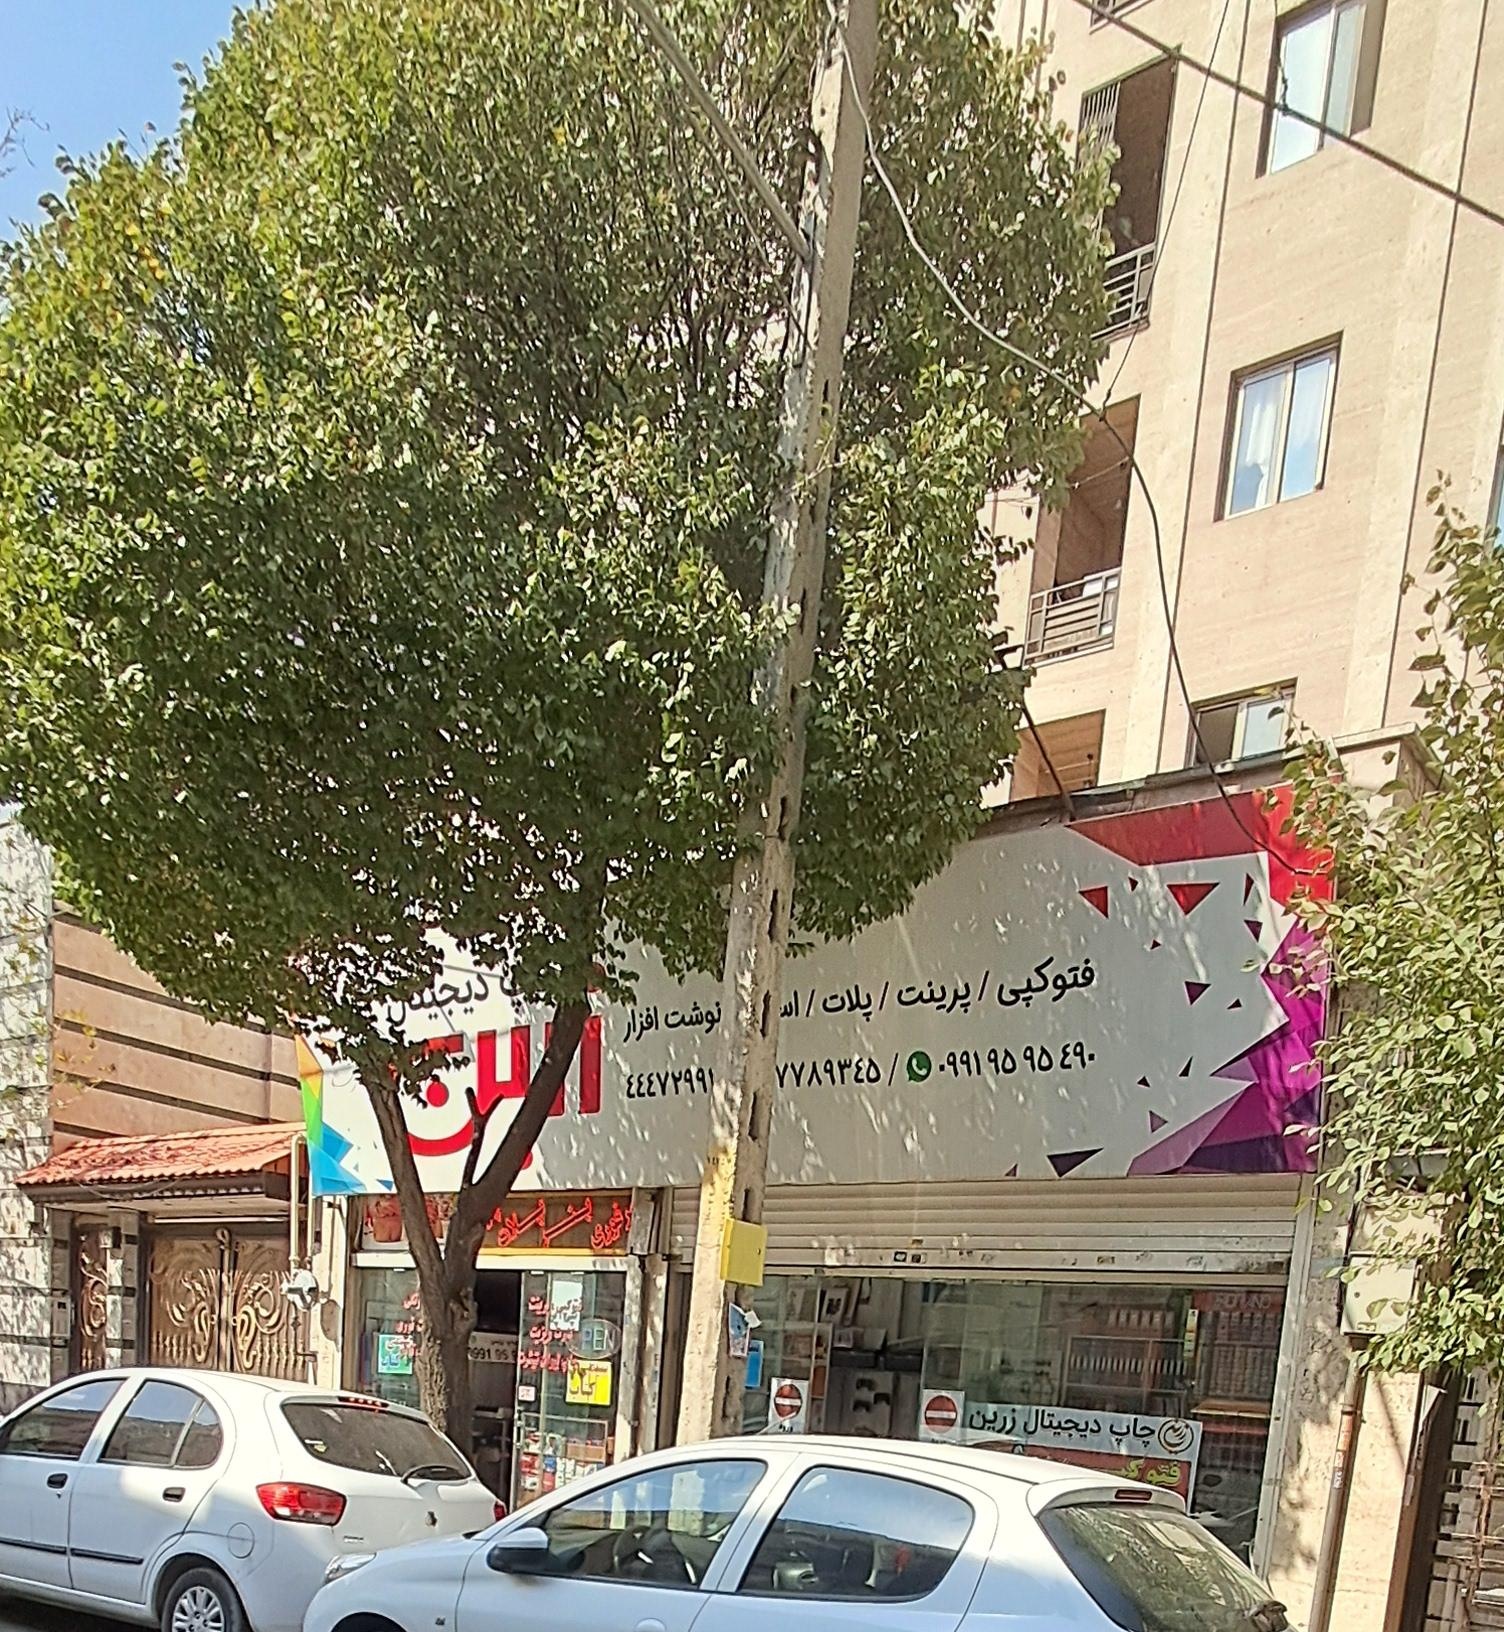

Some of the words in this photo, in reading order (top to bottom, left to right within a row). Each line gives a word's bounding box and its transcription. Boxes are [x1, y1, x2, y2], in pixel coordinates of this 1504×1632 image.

[896, 981, 971, 1015] پرینت
[997, 957, 1096, 1009] فتوکپی
[664, 1001, 722, 1034] نوشت
[821, 985, 873, 1022] پلات
[622, 1006, 659, 1043] افزار
[968, 1407, 1018, 1435] زرین
[1023, 1408, 1102, 1440] دیجیتال
[1109, 1417, 1156, 1447] چاپ
